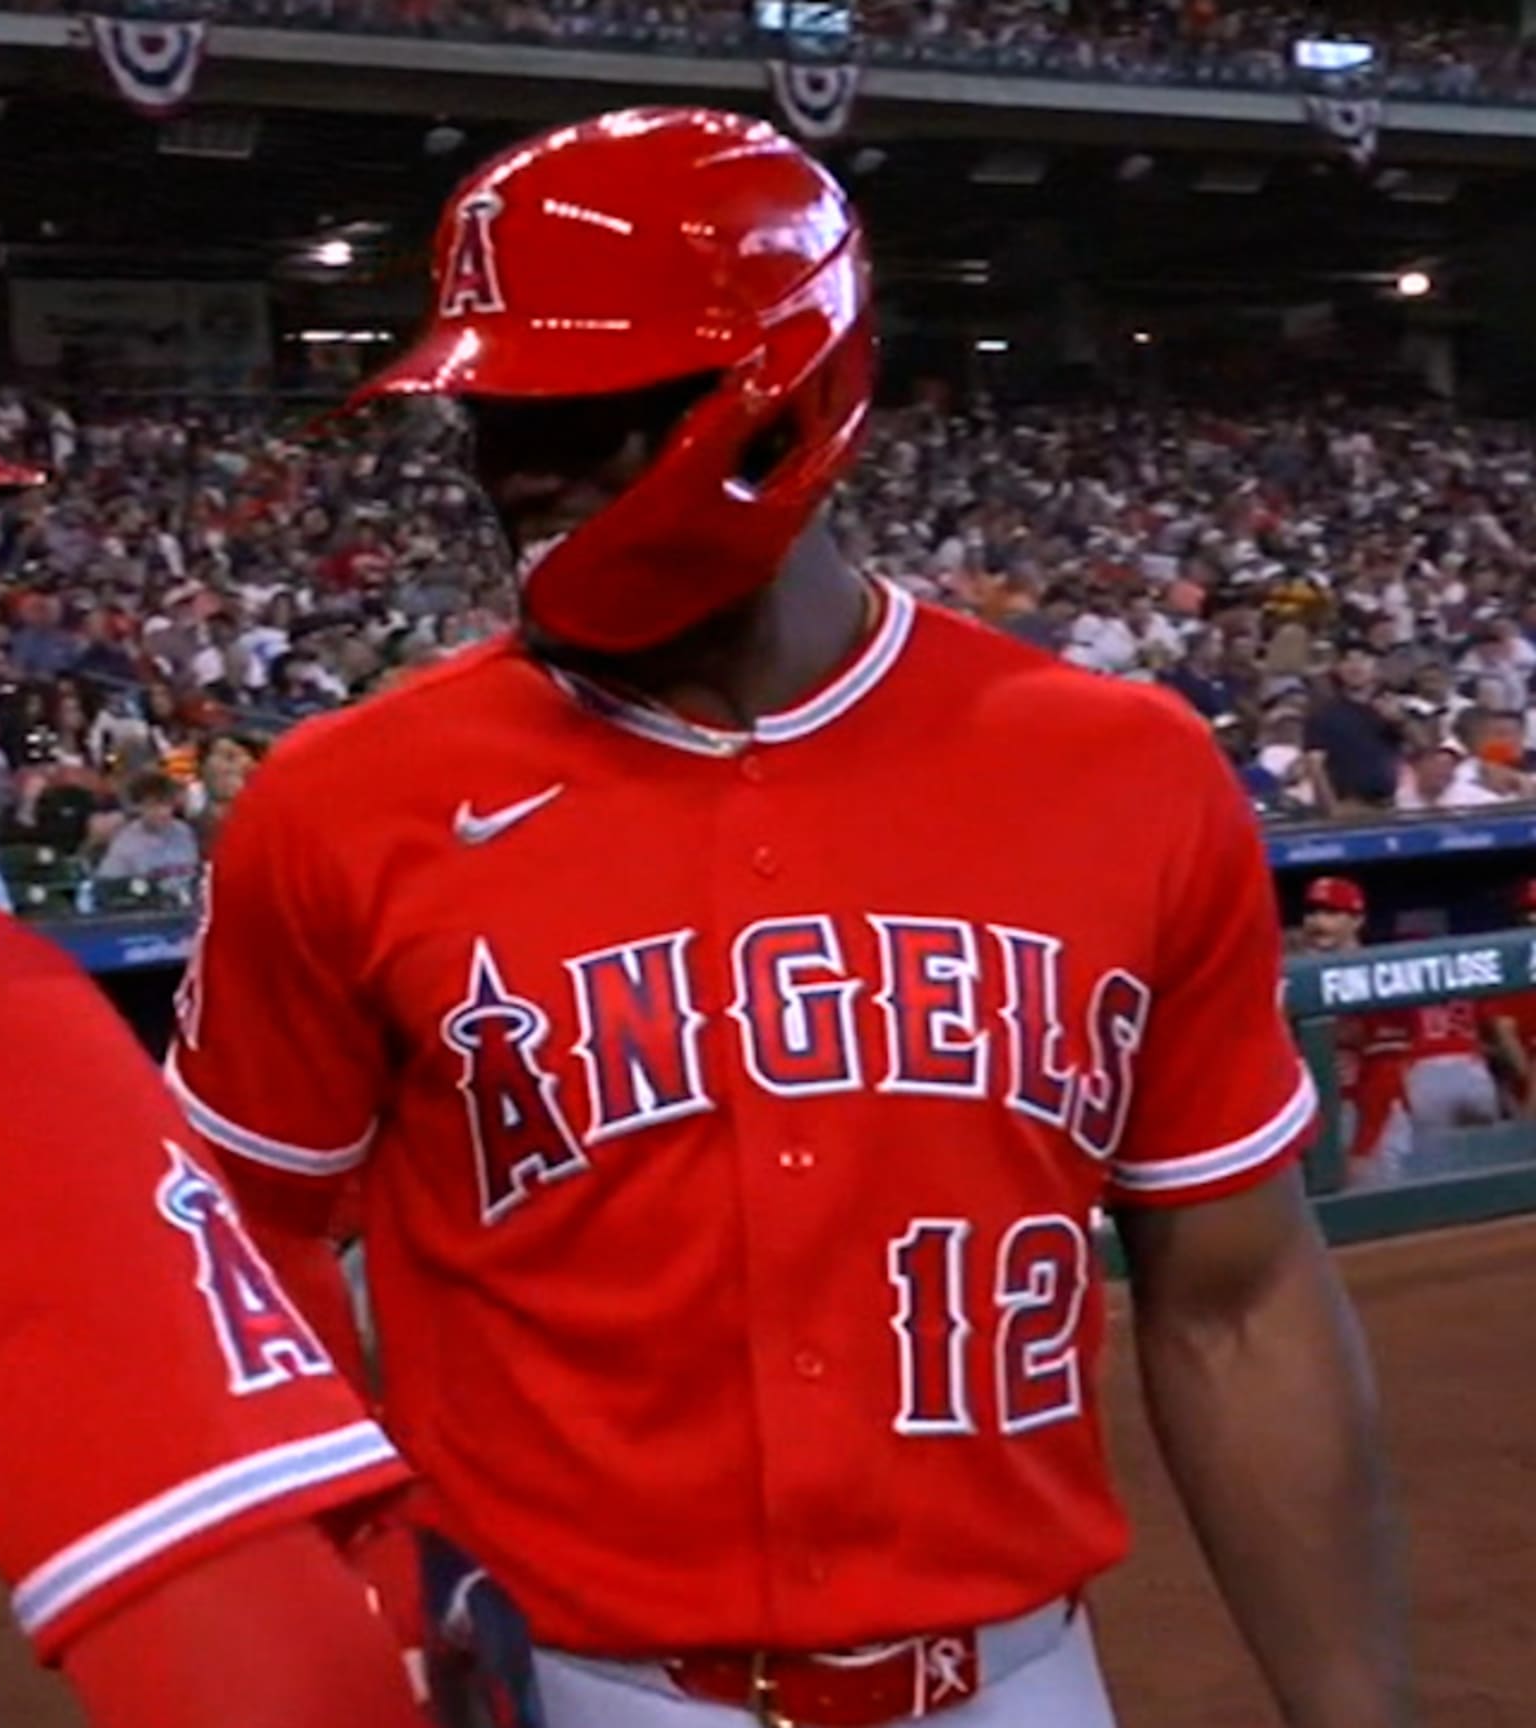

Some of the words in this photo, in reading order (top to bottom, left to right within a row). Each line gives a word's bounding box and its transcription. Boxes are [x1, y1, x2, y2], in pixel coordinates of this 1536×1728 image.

[440, 188, 506, 317] A
[440, 914, 1151, 1225] ANGELS
[1321, 964, 1371, 1005] FUN
[155, 1137, 334, 1395] A
[888, 1214, 1088, 1435] 12
